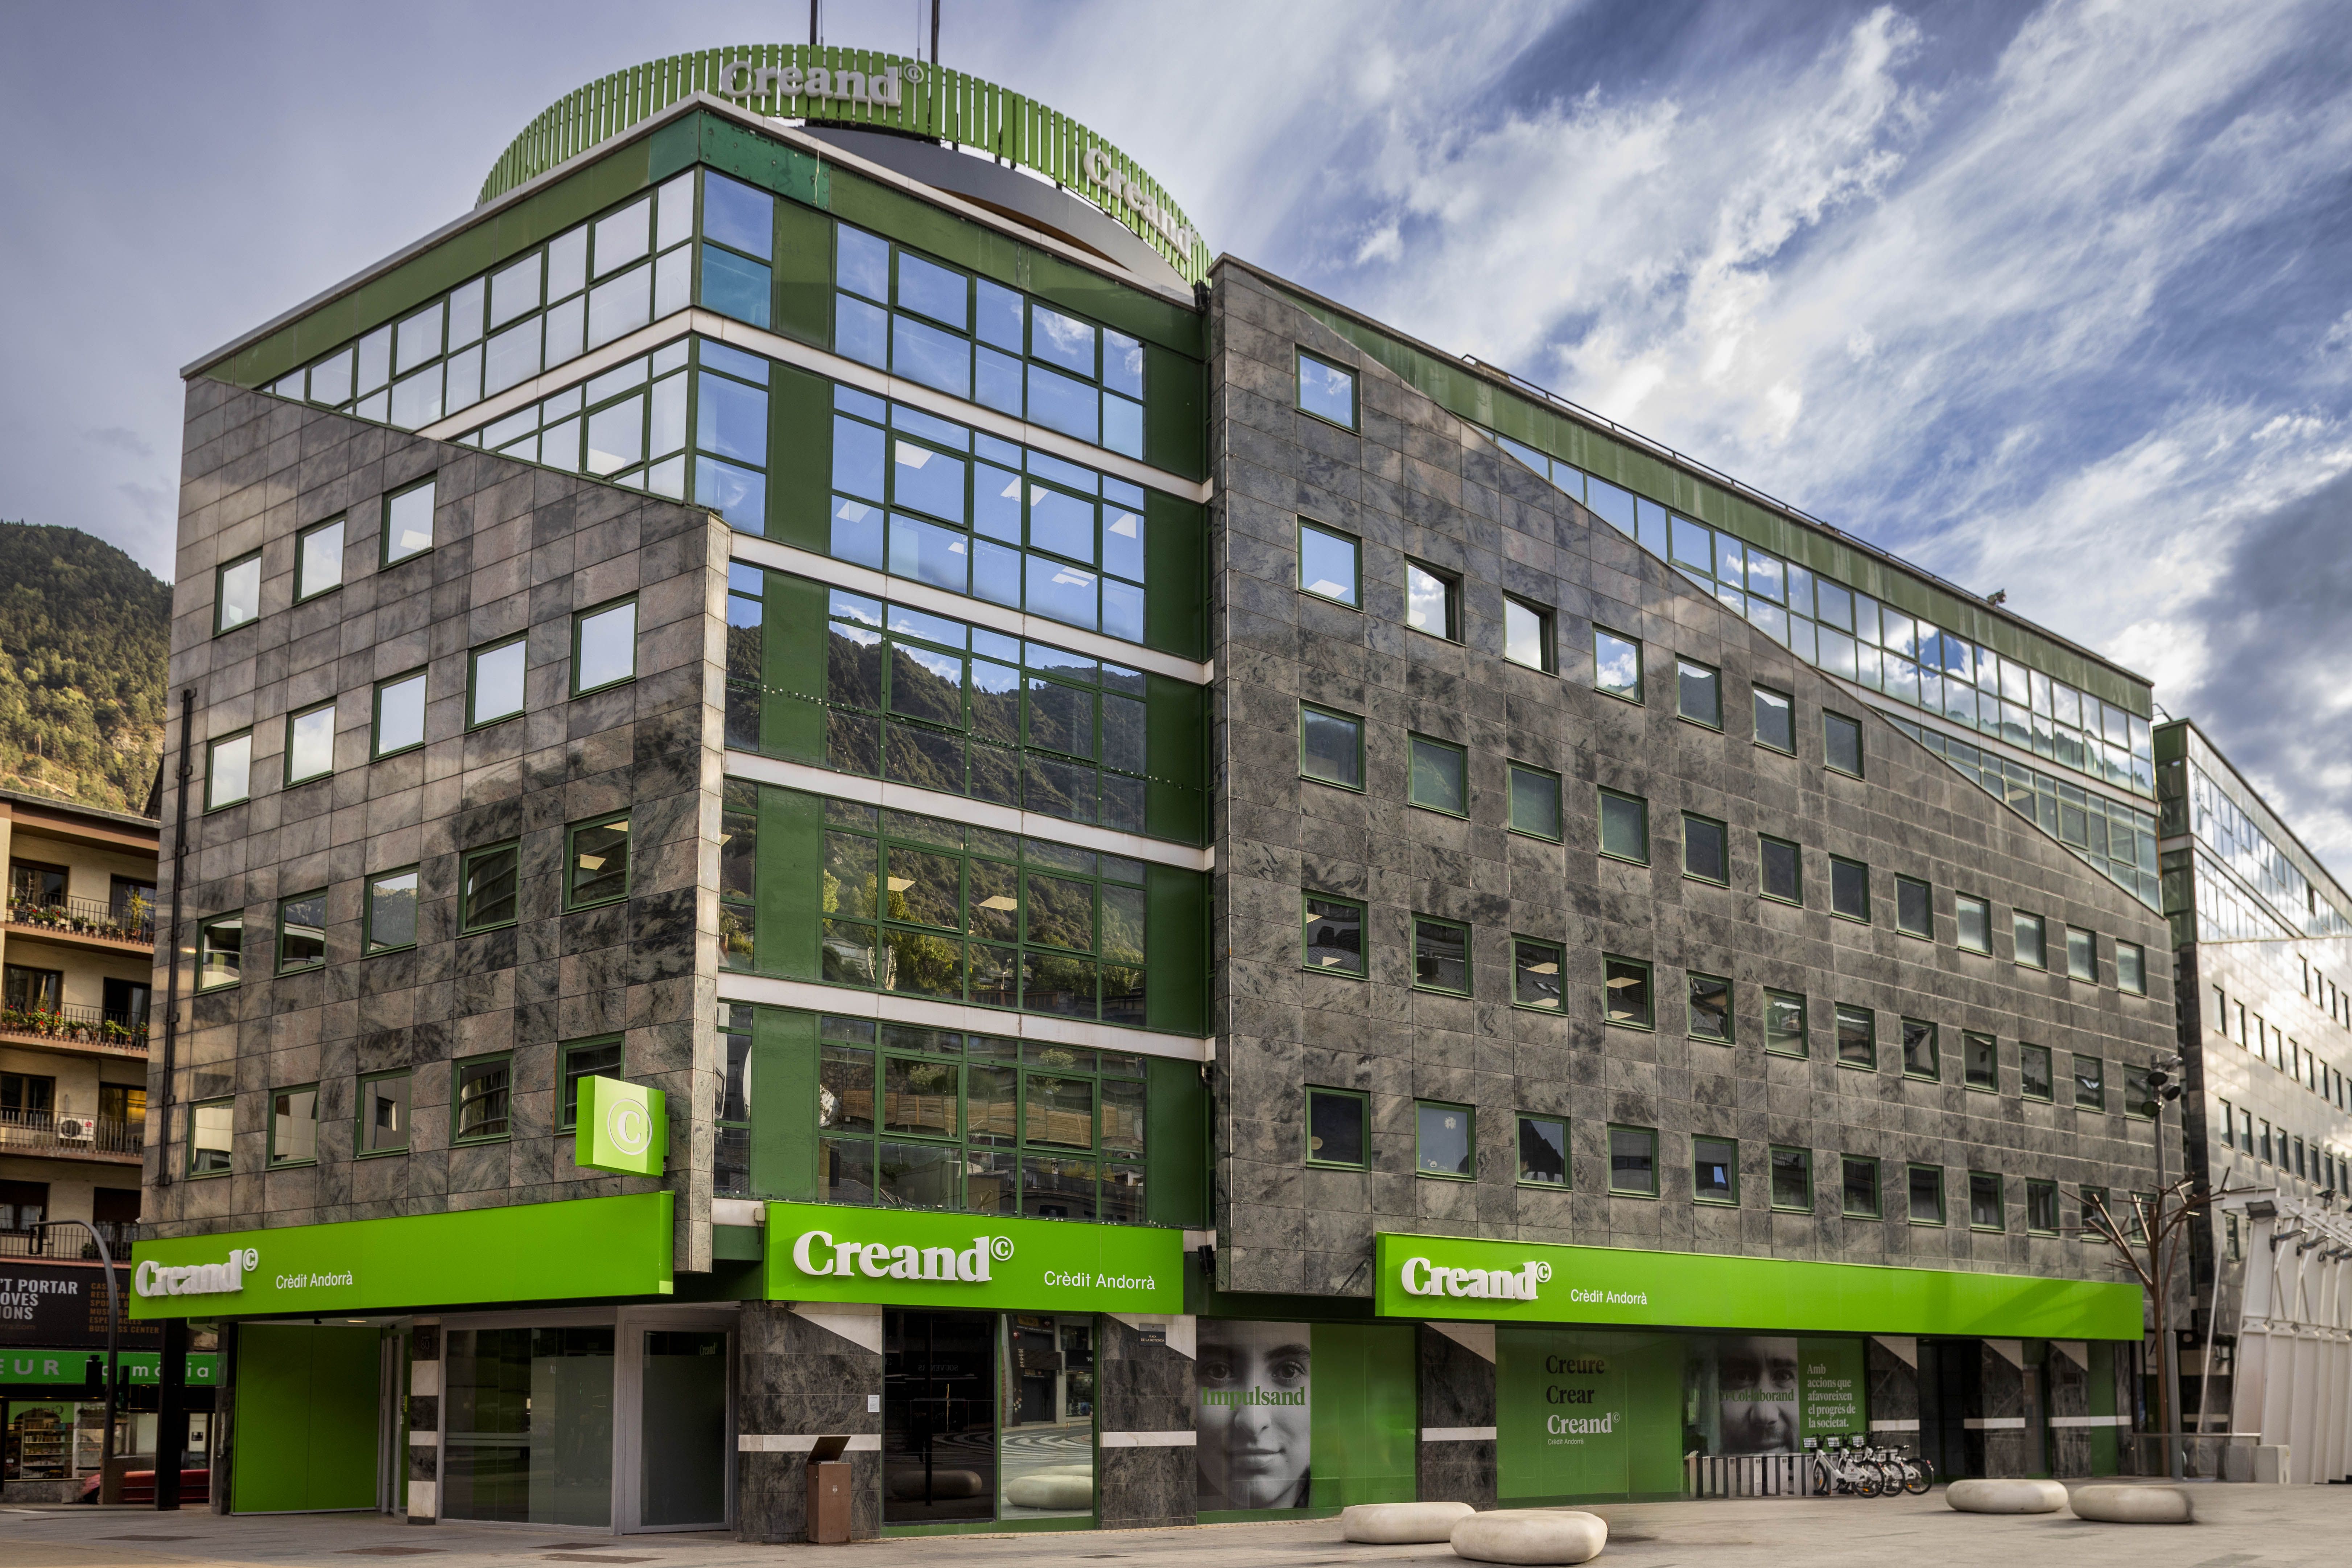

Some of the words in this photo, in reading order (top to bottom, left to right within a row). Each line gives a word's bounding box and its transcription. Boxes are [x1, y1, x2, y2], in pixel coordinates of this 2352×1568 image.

[18, 1279, 78, 1294] PORTAR
[276, 1274, 308, 1290] Crèdit
[310, 1271, 353, 1287] Andorrà
[1044, 1271, 1091, 1287] Crèdit
[1095, 1273, 1156, 1290] Andorrà
[1571, 1289, 1603, 1303] Crèdit
[1606, 1290, 1647, 1305] Andorrà
[0, 1306, 33, 1320] ONS
[1546, 1355, 1605, 1374] Creure
[1807, 1363, 1826, 1374] Amb
[1807, 1377, 1836, 1387] accions
[1837, 1379, 1851, 1390] que
[1202, 1386, 1306, 1410] Impulsand
[1546, 1385, 1594, 1404] Crear
[1808, 1390, 1852, 1401] afavoreixen
[1808, 1404, 1815, 1414] el
[1816, 1403, 1845, 1417] progrés
[1846, 1403, 1856, 1414] de
[1808, 1417, 1816, 1428] la
[1817, 1417, 1849, 1428] societat.
